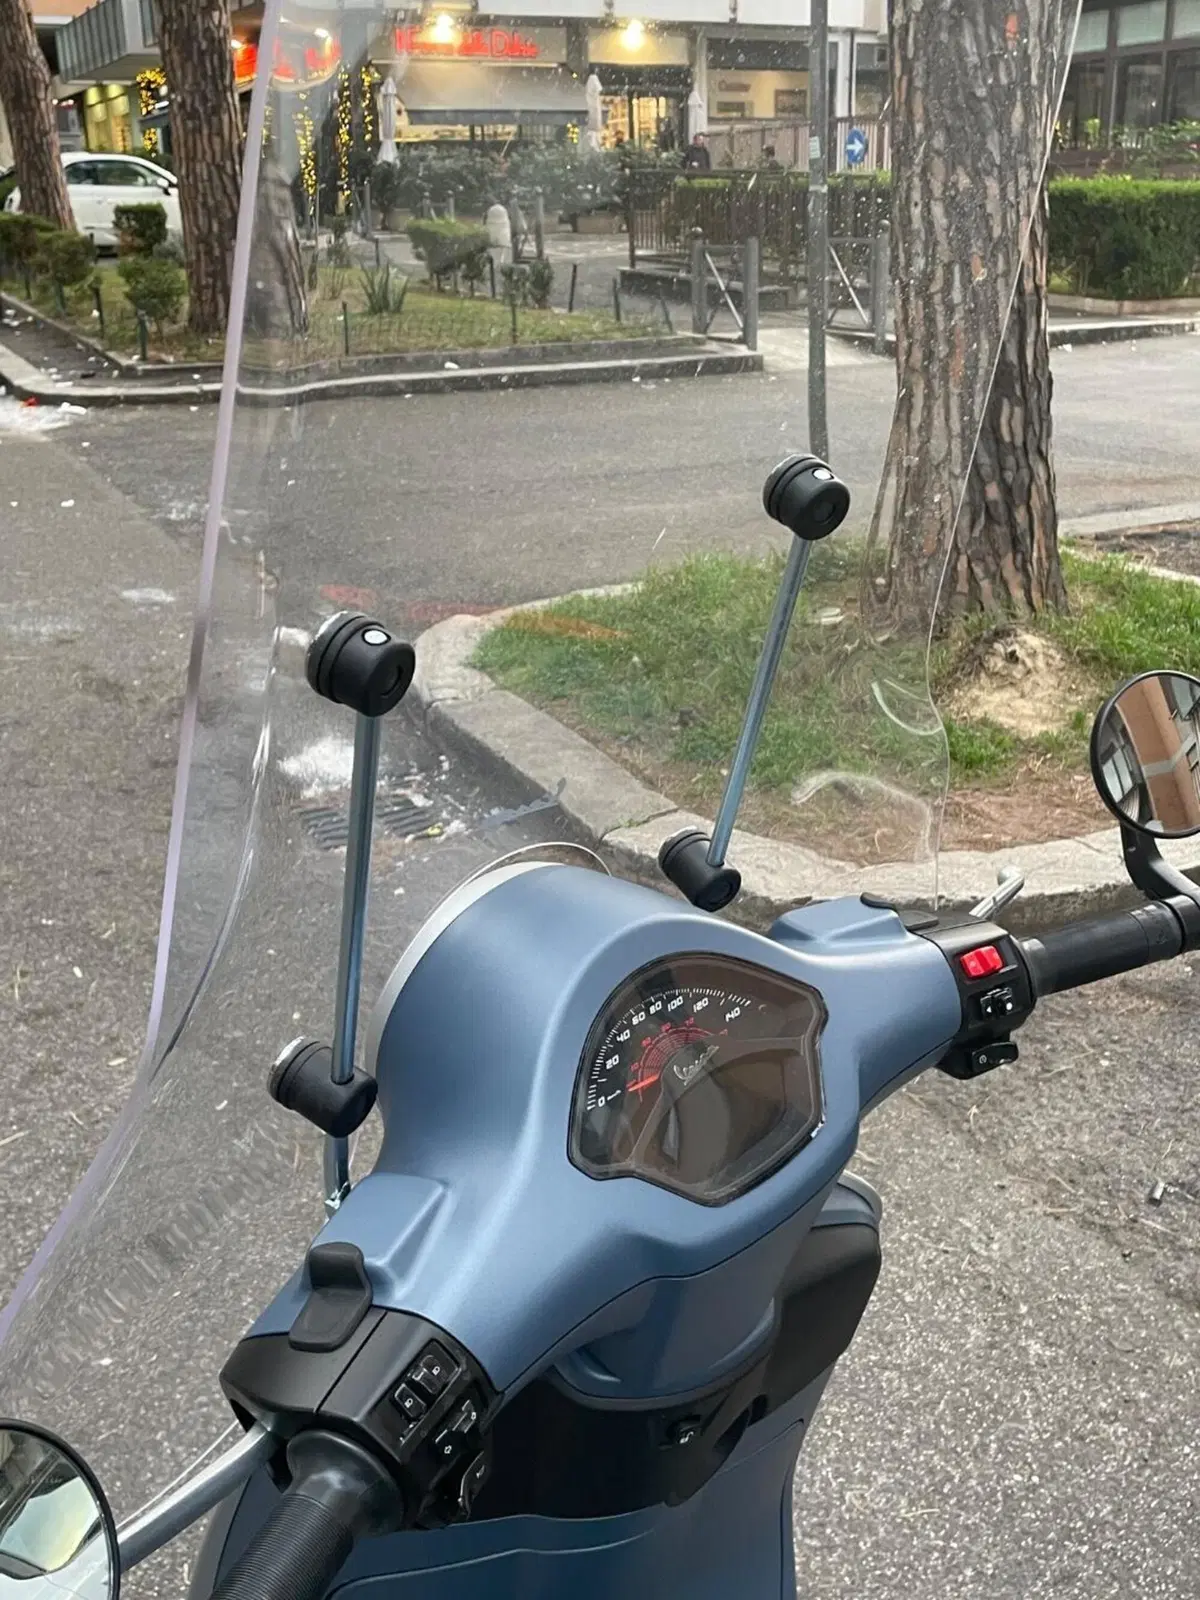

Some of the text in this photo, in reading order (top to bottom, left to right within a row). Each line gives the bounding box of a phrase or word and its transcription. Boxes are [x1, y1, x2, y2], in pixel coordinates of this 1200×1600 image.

[649, 1000, 663, 1015] 80
[667, 995, 684, 1012] 100
[693, 997, 709, 1013] 120
[725, 1007, 741, 1023] 140
[616, 1029, 631, 1043] 40
[605, 1054, 620, 1070] 20
[597, 1095, 606, 1108] 0
